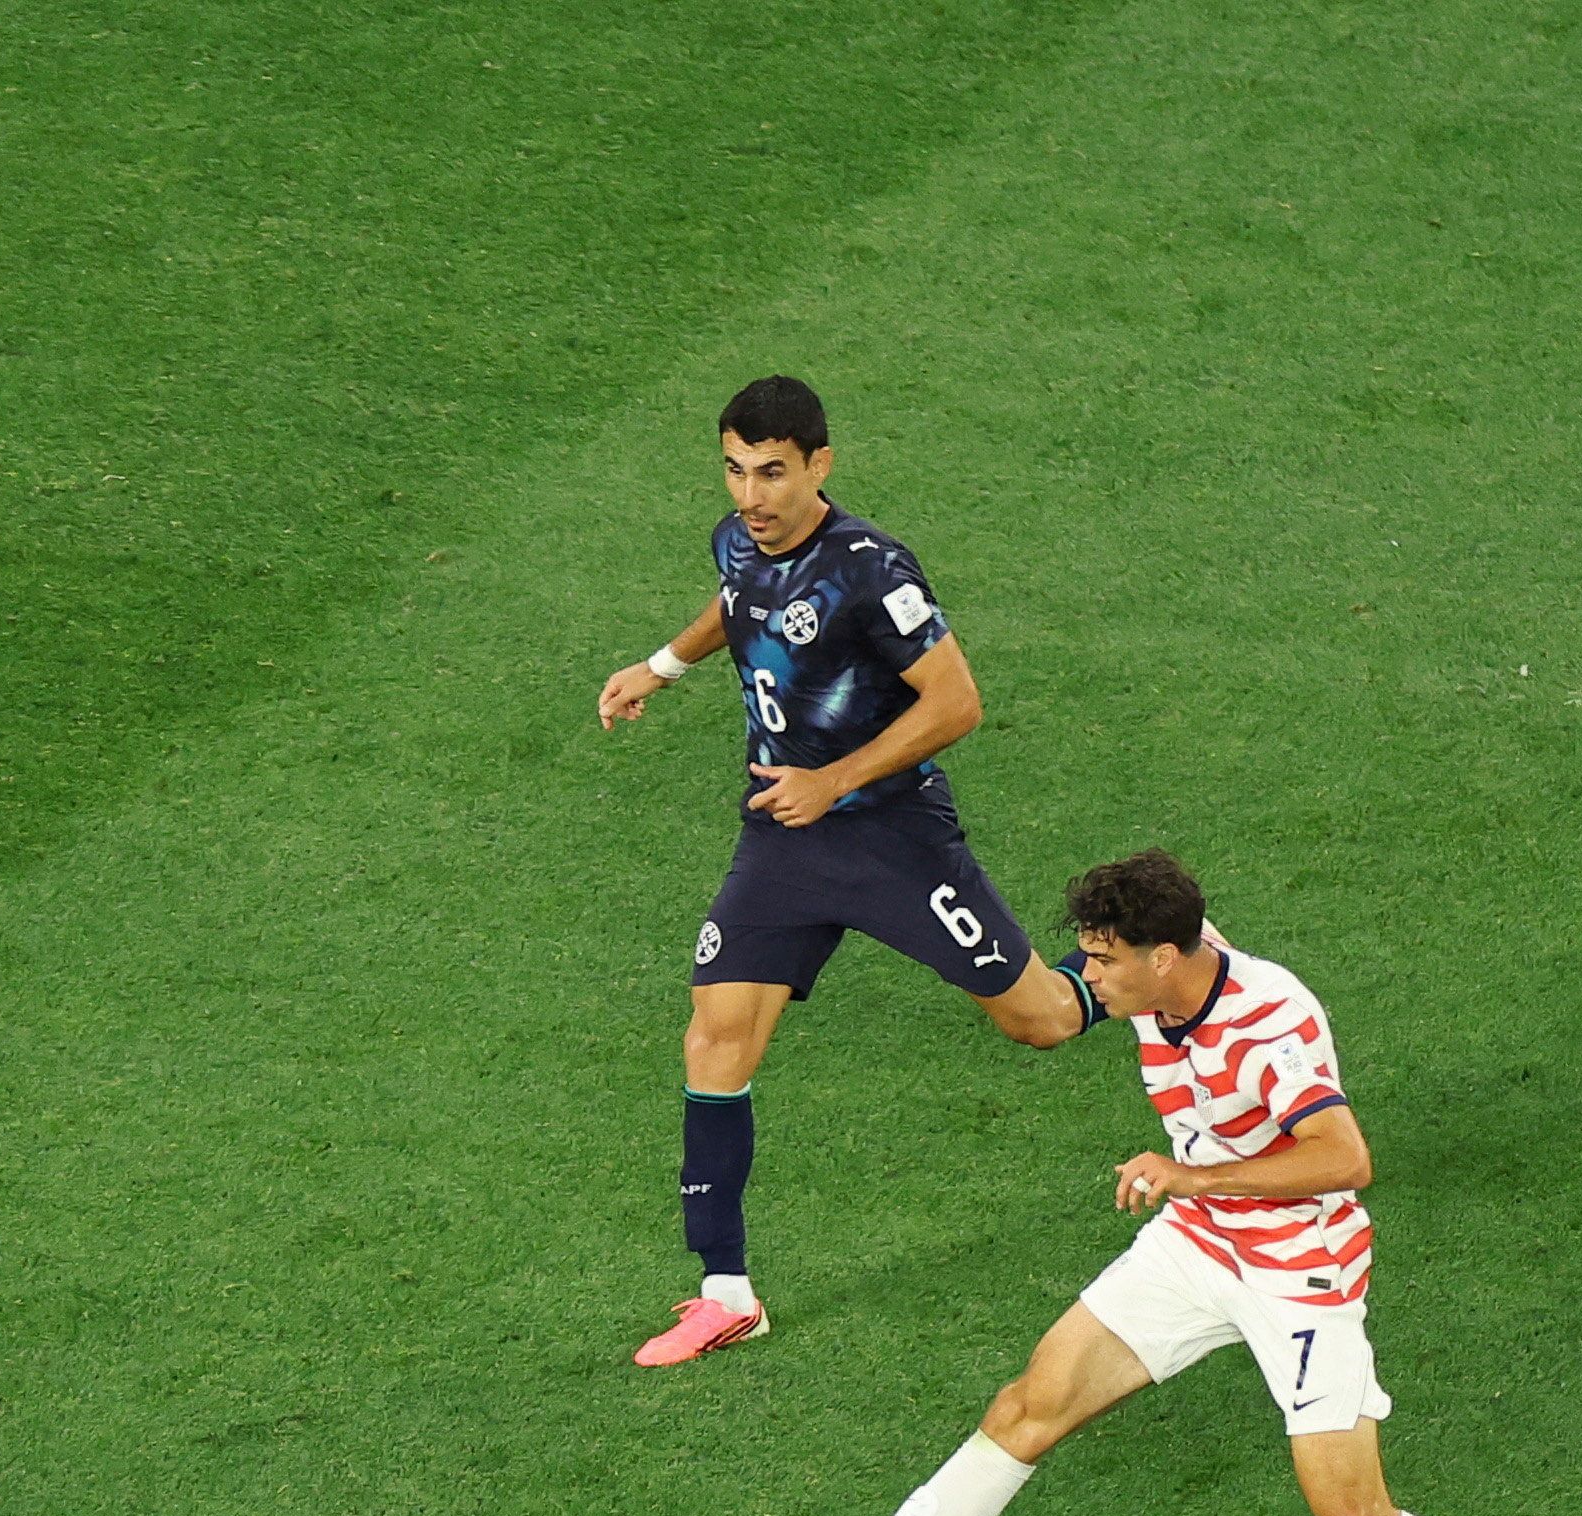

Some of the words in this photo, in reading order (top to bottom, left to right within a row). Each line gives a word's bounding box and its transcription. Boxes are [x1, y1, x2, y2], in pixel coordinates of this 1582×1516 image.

[753, 669, 787, 733] 6
[930, 883, 983, 948] 6
[680, 1183, 712, 1195] APF
[1291, 1329, 1316, 1390] 7
